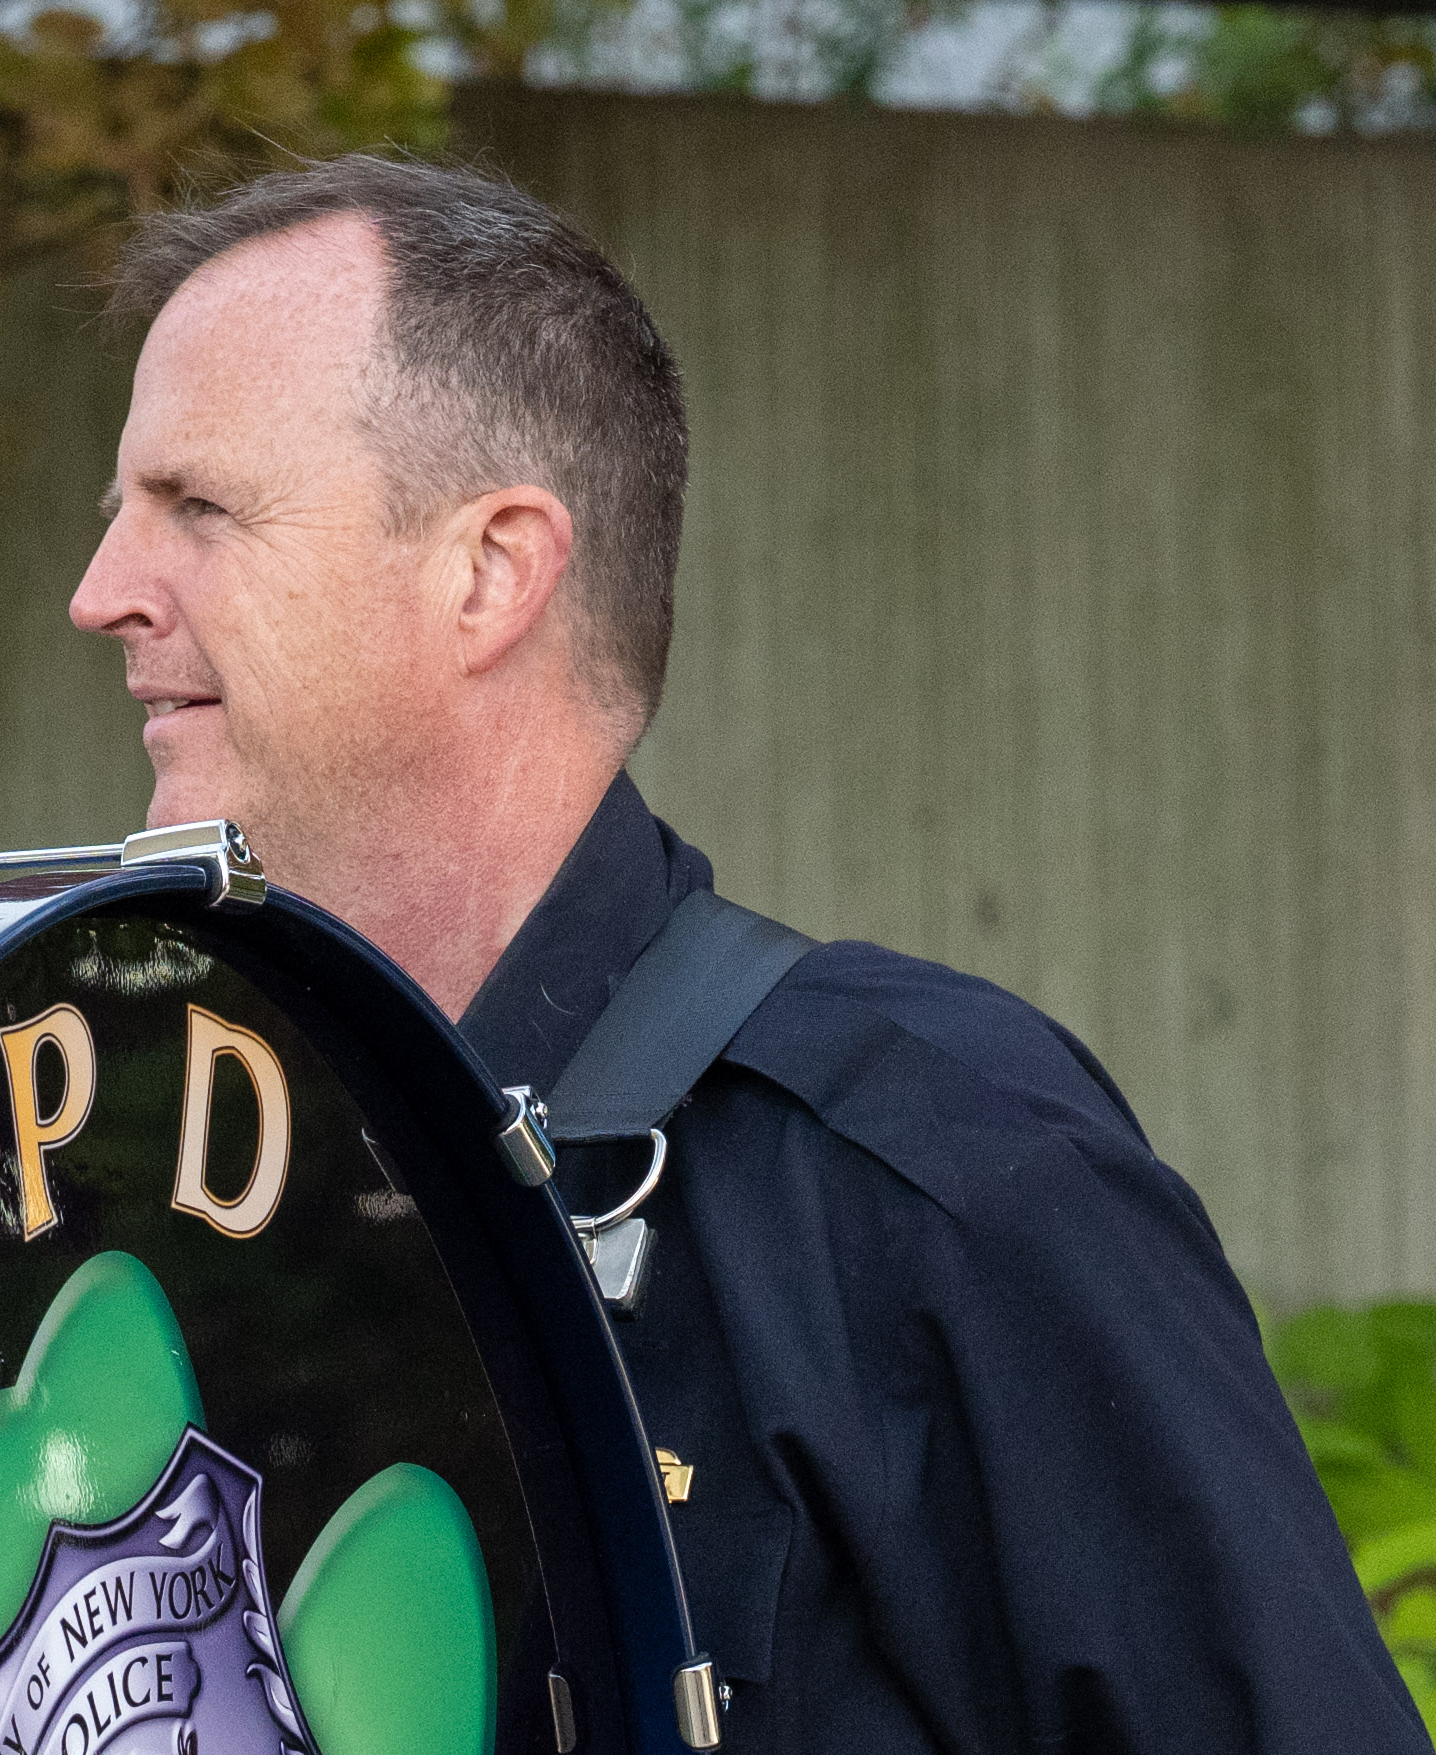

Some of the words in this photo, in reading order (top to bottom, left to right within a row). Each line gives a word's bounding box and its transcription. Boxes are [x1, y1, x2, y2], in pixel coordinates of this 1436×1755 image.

[26, 1653, 56, 1711] OF
[60, 1571, 136, 1663] NEW
[149, 1543, 239, 1620] YORK
